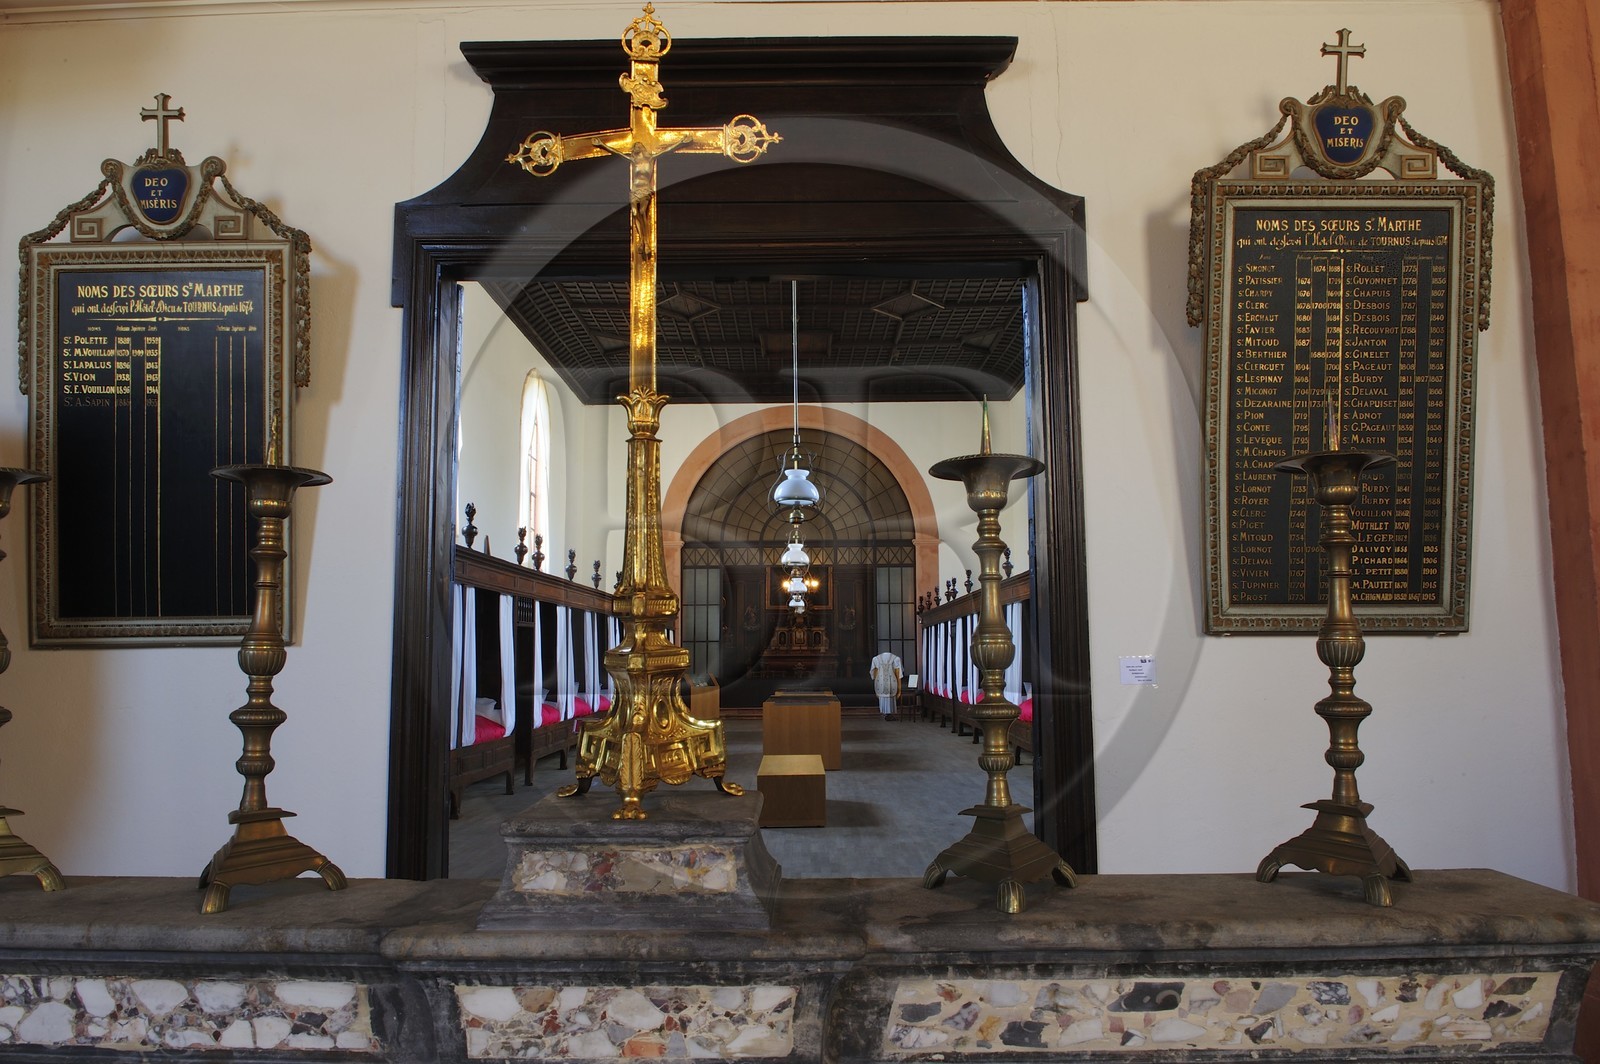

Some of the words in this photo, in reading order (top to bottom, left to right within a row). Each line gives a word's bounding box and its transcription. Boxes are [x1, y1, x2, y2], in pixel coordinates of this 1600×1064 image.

[1334, 116, 1359, 125] DEO
[1340, 127, 1353, 135] ET
[145, 177, 168, 187] DEO
[1256, 219, 1289, 231] NOMS
[1295, 220, 1315, 231] DES
[1378, 217, 1422, 231] MARTHE
[1237, 236, 1250, 248] qui
[1371, 237, 1410, 246] TOURNUS
[1353, 263, 1385, 273] ROLLET
[1245, 275, 1282, 285] PATISSIER
[1353, 276, 1398, 285] GUYONNET
[77, 285, 108, 298] NOMS
[113, 285, 135, 298] DES
[139, 285, 178, 297] SŒURS
[194, 283, 244, 297] MARTHE
[1245, 288, 1273, 297] CHARPY
[1353, 288, 1390, 297] CHAPUIS
[72, 303, 85, 315] qui
[183, 302, 217, 312] TOURNUS
[217, 302, 238, 316] depuis
[1246, 301, 1269, 309] CLERC
[1353, 300, 1390, 310] DESBOIS
[1245, 313, 1279, 322] ERCHAUT
[1353, 312, 1390, 322] DESBOIS
[1245, 325, 1275, 334] FAVIER
[1353, 325, 1398, 334] RECOUVROT
[74, 336, 108, 345] POLETTE
[1245, 337, 1279, 346] MITOUD
[1352, 337, 1387, 346] JANTON
[1245, 350, 1287, 358] BERTHIER
[1353, 350, 1390, 359] GIMELET
[73, 361, 111, 369] LAPALUS
[1245, 362, 1285, 371] CLERGUET
[1353, 361, 1392, 371] PAGEAUT
[73, 372, 96, 381] VION
[1245, 373, 1283, 383] LESPINAY
[1353, 373, 1383, 383] BURDY
[1352, 386, 1388, 396] DELAVAL
[1244, 398, 1291, 408] DEZARAINE
[1351, 398, 1397, 408] CHAPUISET
[1244, 411, 1264, 420] PION
[1352, 410, 1382, 420] ADNOT
[1244, 423, 1270, 432] CONTE
[1351, 435, 1385, 444] MARTIN
[1243, 472, 1277, 481] LAURENT
[1243, 484, 1272, 493] LORNOT
[1362, 483, 1390, 493] BURDY
[1242, 496, 1270, 505] ROYER
[1362, 495, 1391, 505] BURDY
[1240, 508, 1266, 517] CLERC
[1350, 506, 1392, 517] VOUILLON
[1240, 520, 1264, 529] PIGET
[1351, 520, 1389, 530] MUTHLET
[1240, 532, 1273, 541] MITOUD
[1241, 544, 1272, 553] LORNOT
[1352, 545, 1392, 553] DALIVOY
[1241, 556, 1273, 565] DELAVAL
[1352, 556, 1393, 564] PICHARD
[1240, 569, 1269, 577] VIVIEN
[1241, 581, 1280, 589] TUPINIER
[1423, 581, 1437, 589] 1915
[1241, 592, 1268, 601] PROST
[1423, 593, 1436, 601] 1915
